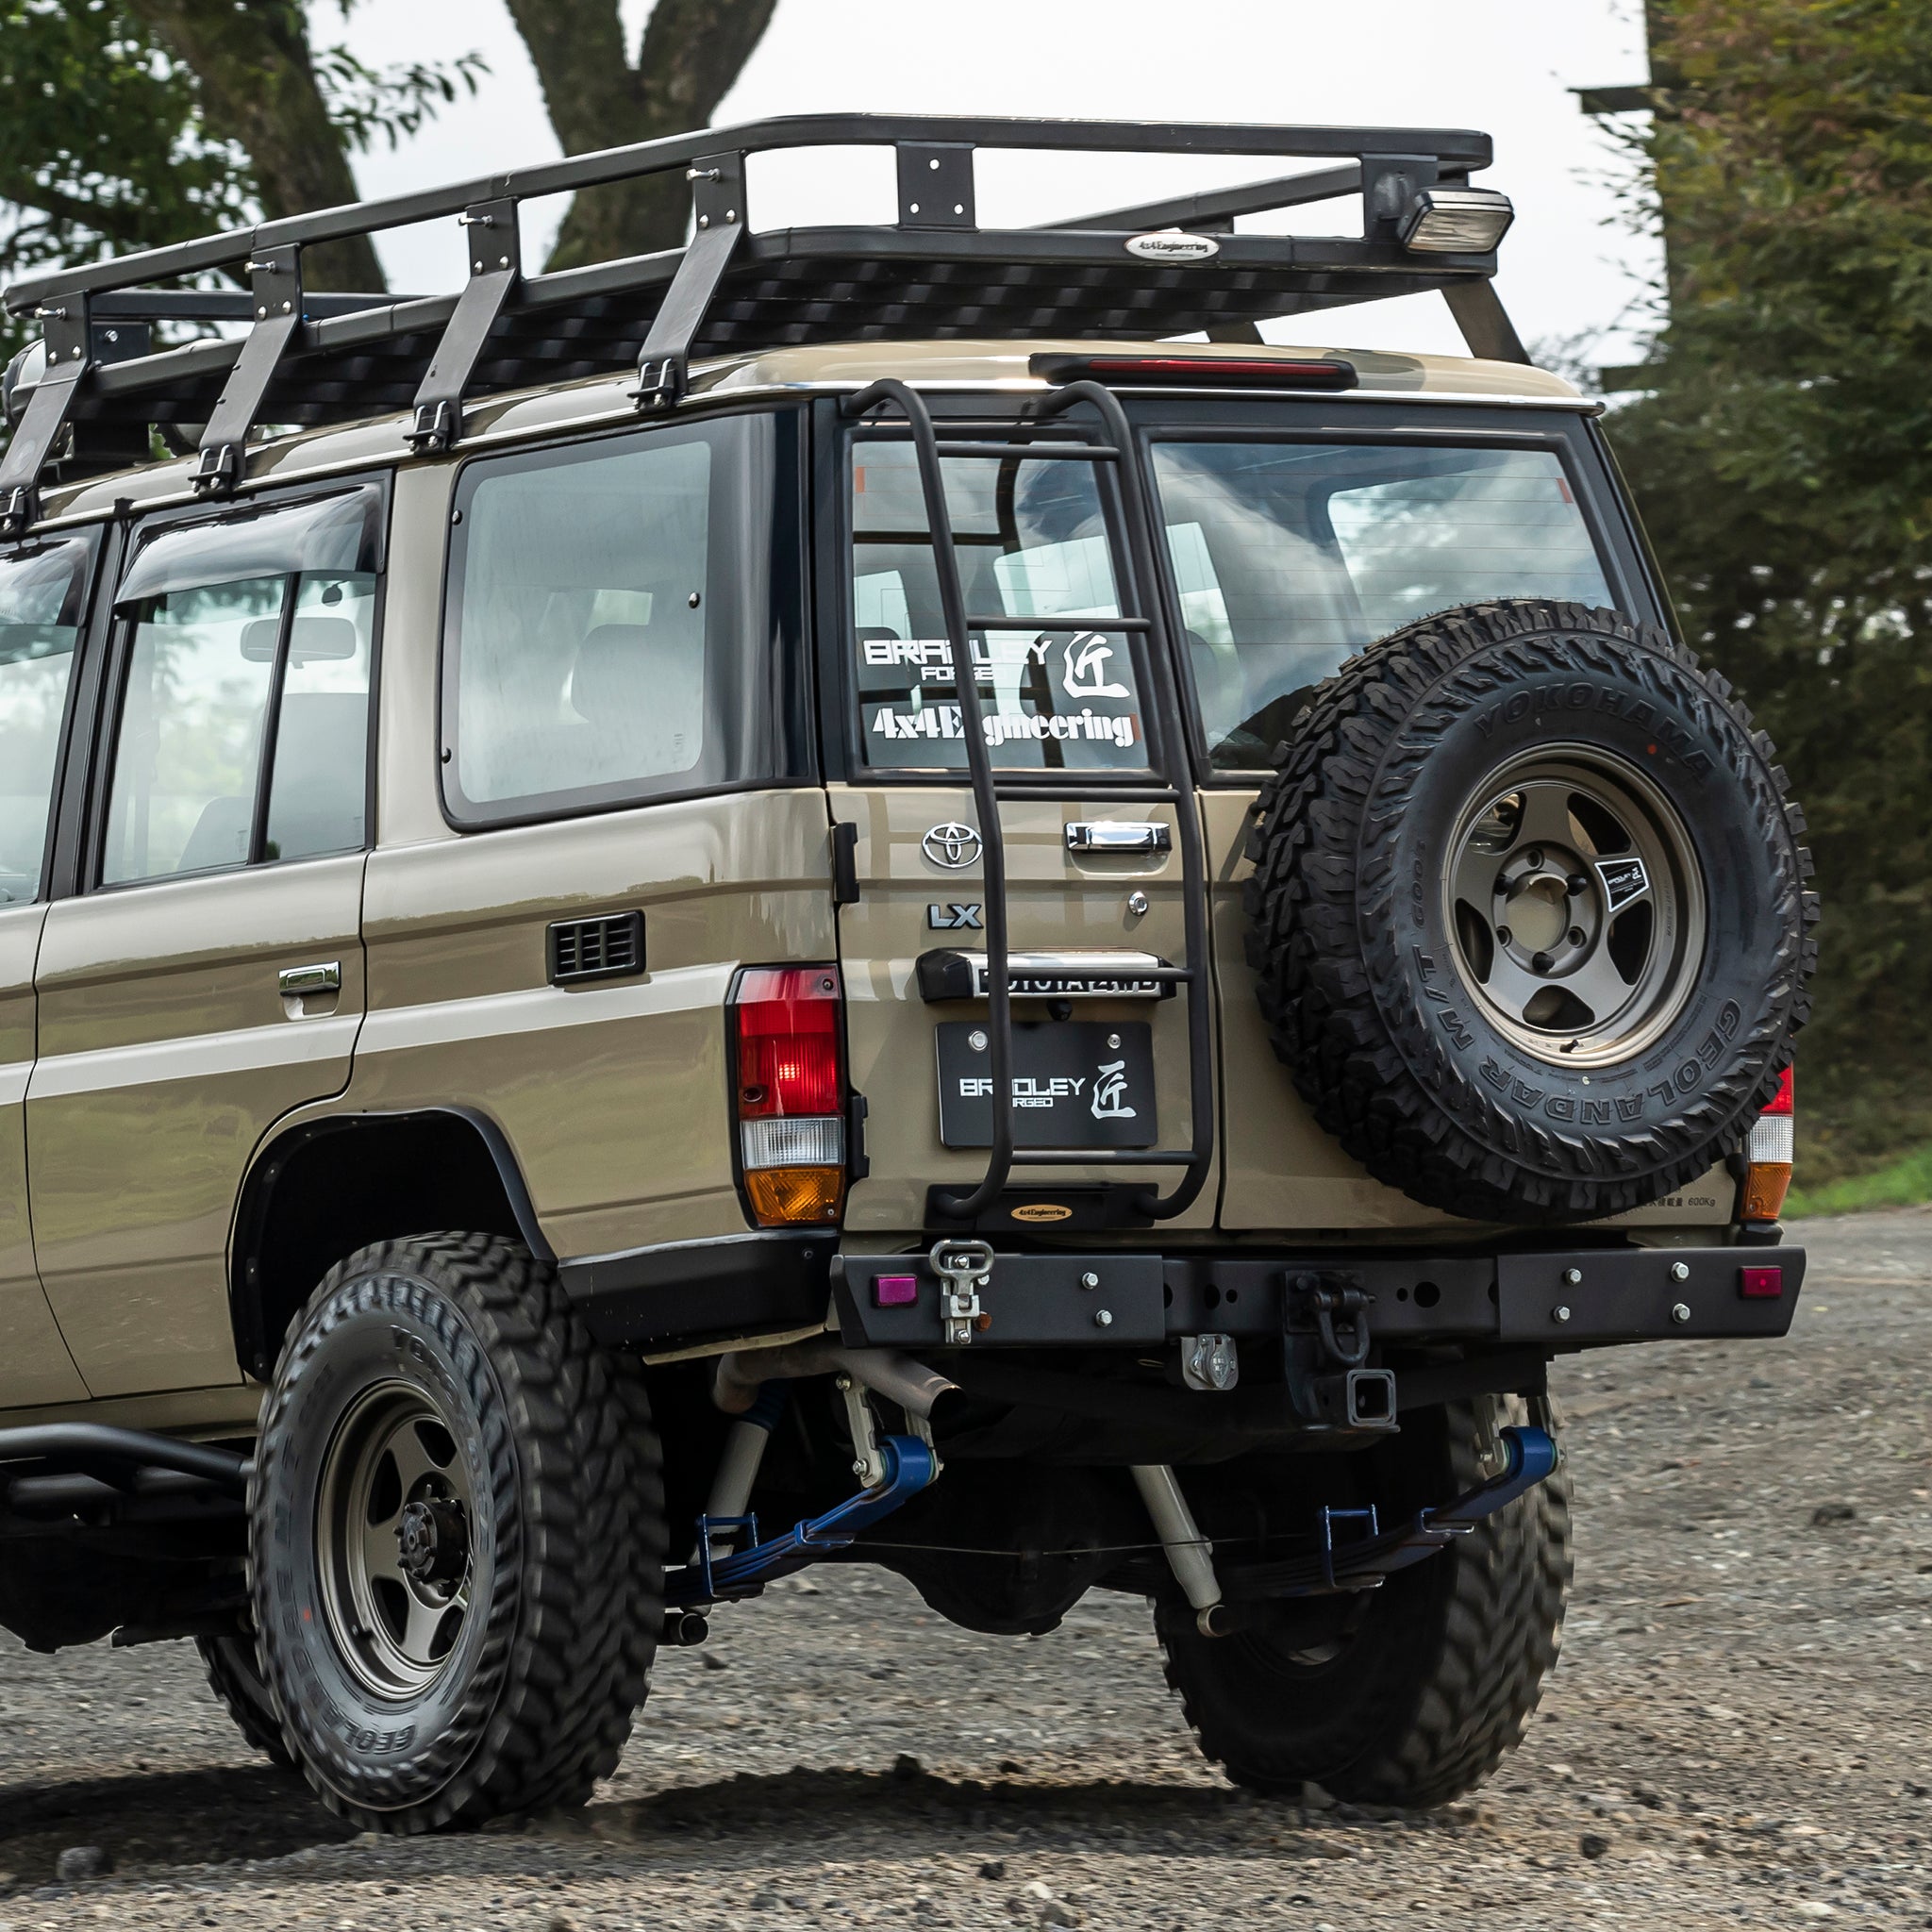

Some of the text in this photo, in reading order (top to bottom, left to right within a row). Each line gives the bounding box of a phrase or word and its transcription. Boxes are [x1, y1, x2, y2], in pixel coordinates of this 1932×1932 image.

[873, 706, 1134, 747] 4x4Egineering
[1473, 681, 1717, 780] YOKOHAMA
[927, 903, 984, 929] LX
[1413, 944, 1475, 1051] M/T
[1479, 998, 1742, 1124] GEOLANDAR
[959, 1077, 1086, 1096] BRDLEY
[1011, 1097, 1054, 1108] RGED
[1091, 1060, 1137, 1120] 匠
